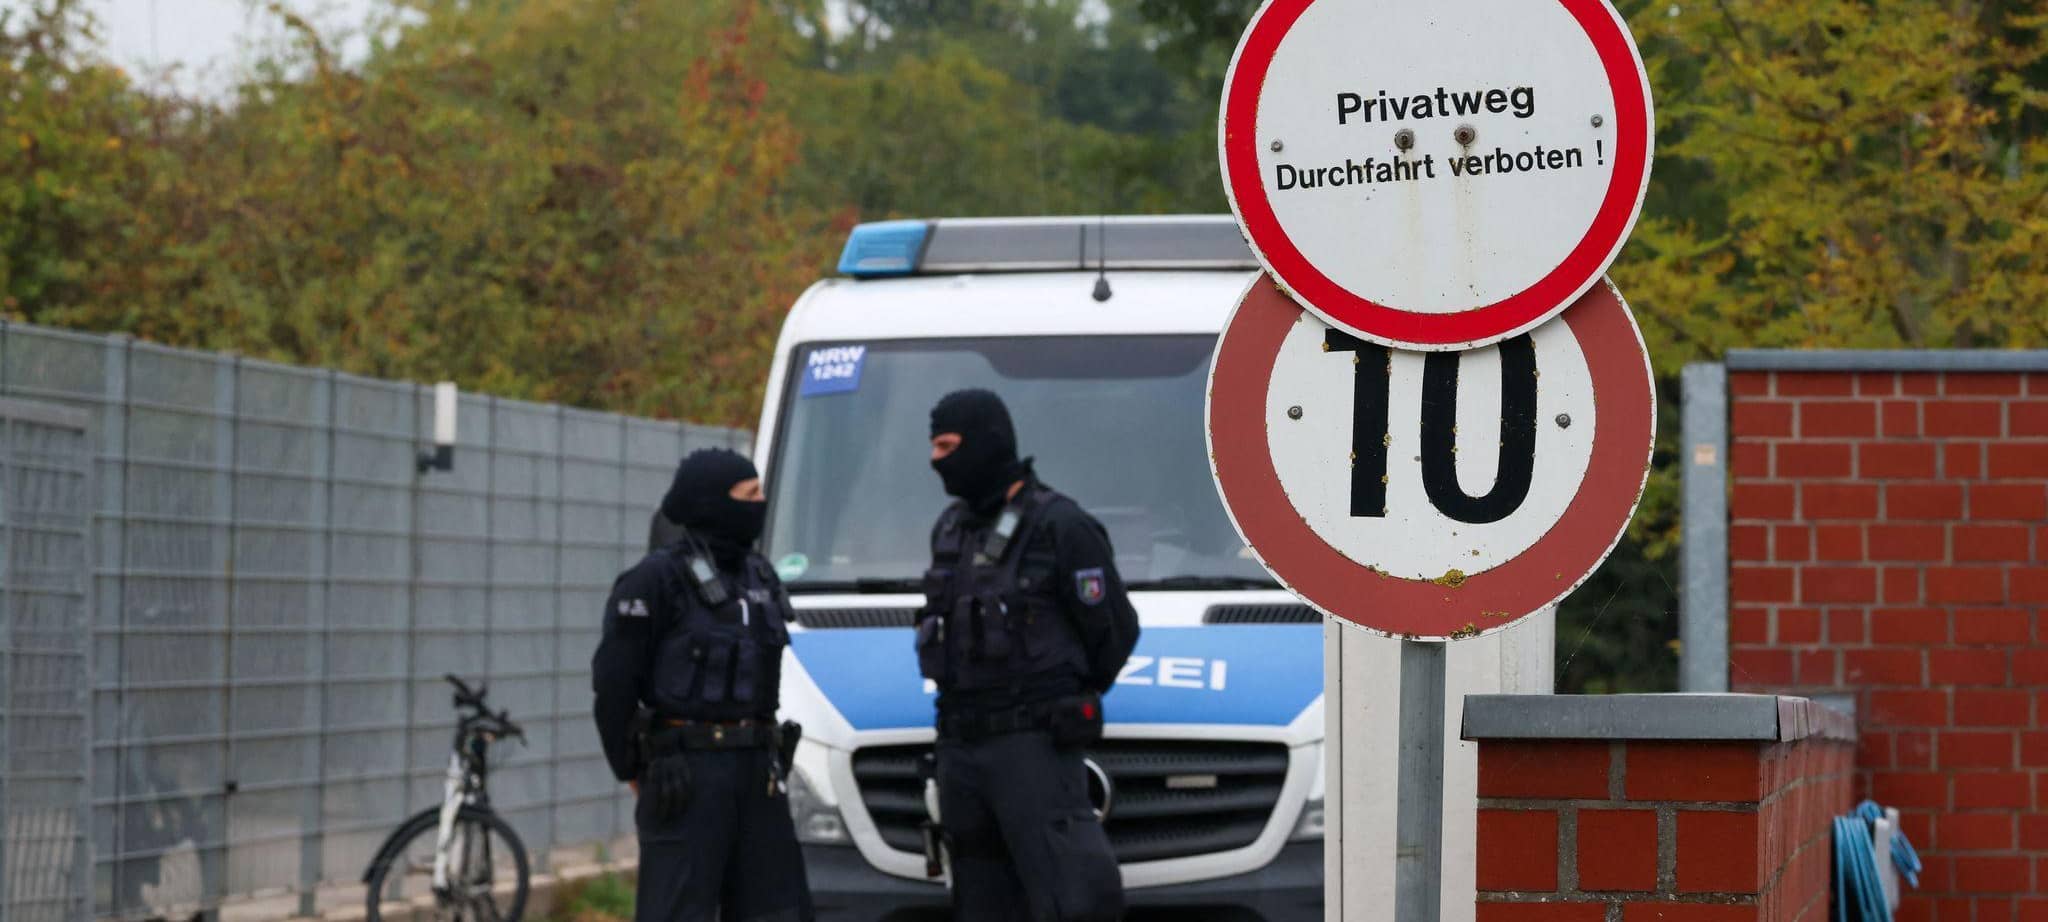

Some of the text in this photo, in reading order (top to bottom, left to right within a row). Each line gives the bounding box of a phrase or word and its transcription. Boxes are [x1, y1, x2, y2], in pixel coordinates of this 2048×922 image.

[1336, 86, 1534, 125] Privatweg
[1276, 139, 1604, 190] Durchfahrt verboten !
[808, 345, 865, 367] NRW
[1324, 328, 1538, 524] 10
